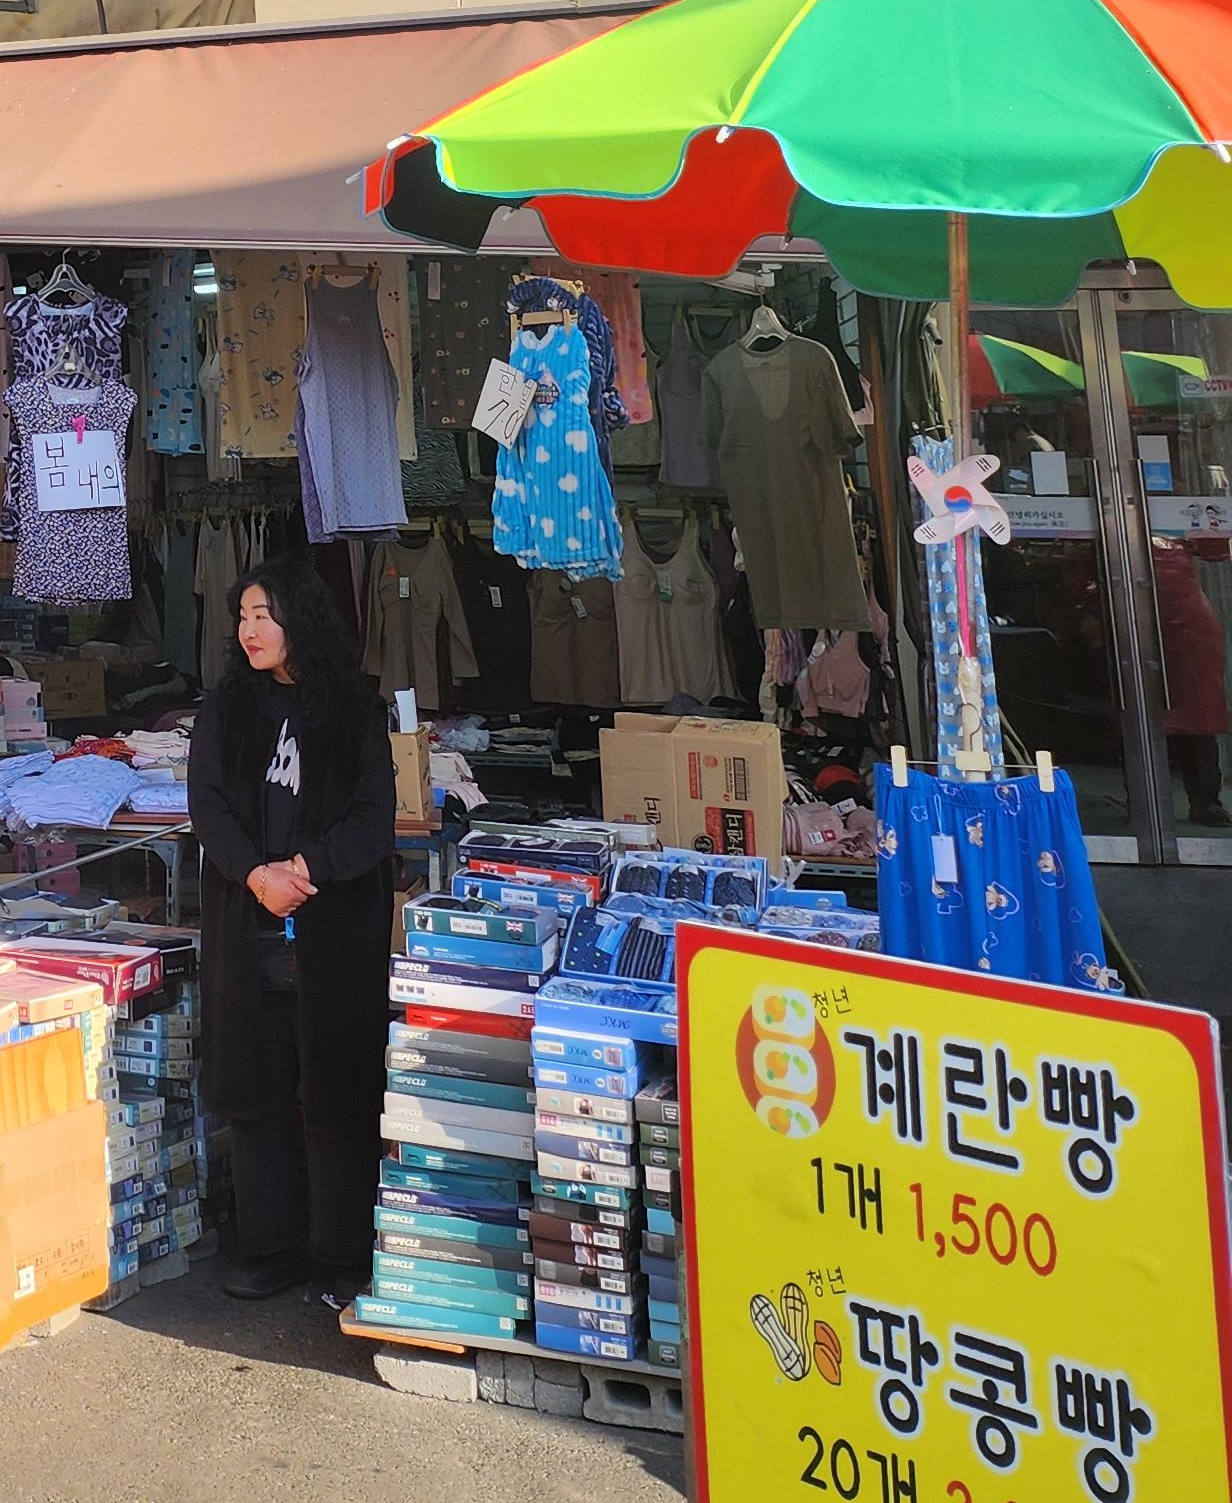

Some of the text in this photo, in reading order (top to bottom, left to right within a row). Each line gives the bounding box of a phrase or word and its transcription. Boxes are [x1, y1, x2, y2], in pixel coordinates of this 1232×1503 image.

[78, 460, 122, 504] 내의
[812, 985, 852, 1019] 청년
[843, 1031, 1136, 1194] 계란빵
[810, 1156, 1058, 1278] 1개 1,500
[806, 1266, 848, 1297] 청년
[849, 1301, 1153, 1503] 땅콩빵
[797, 1426, 917, 1503] 20개
